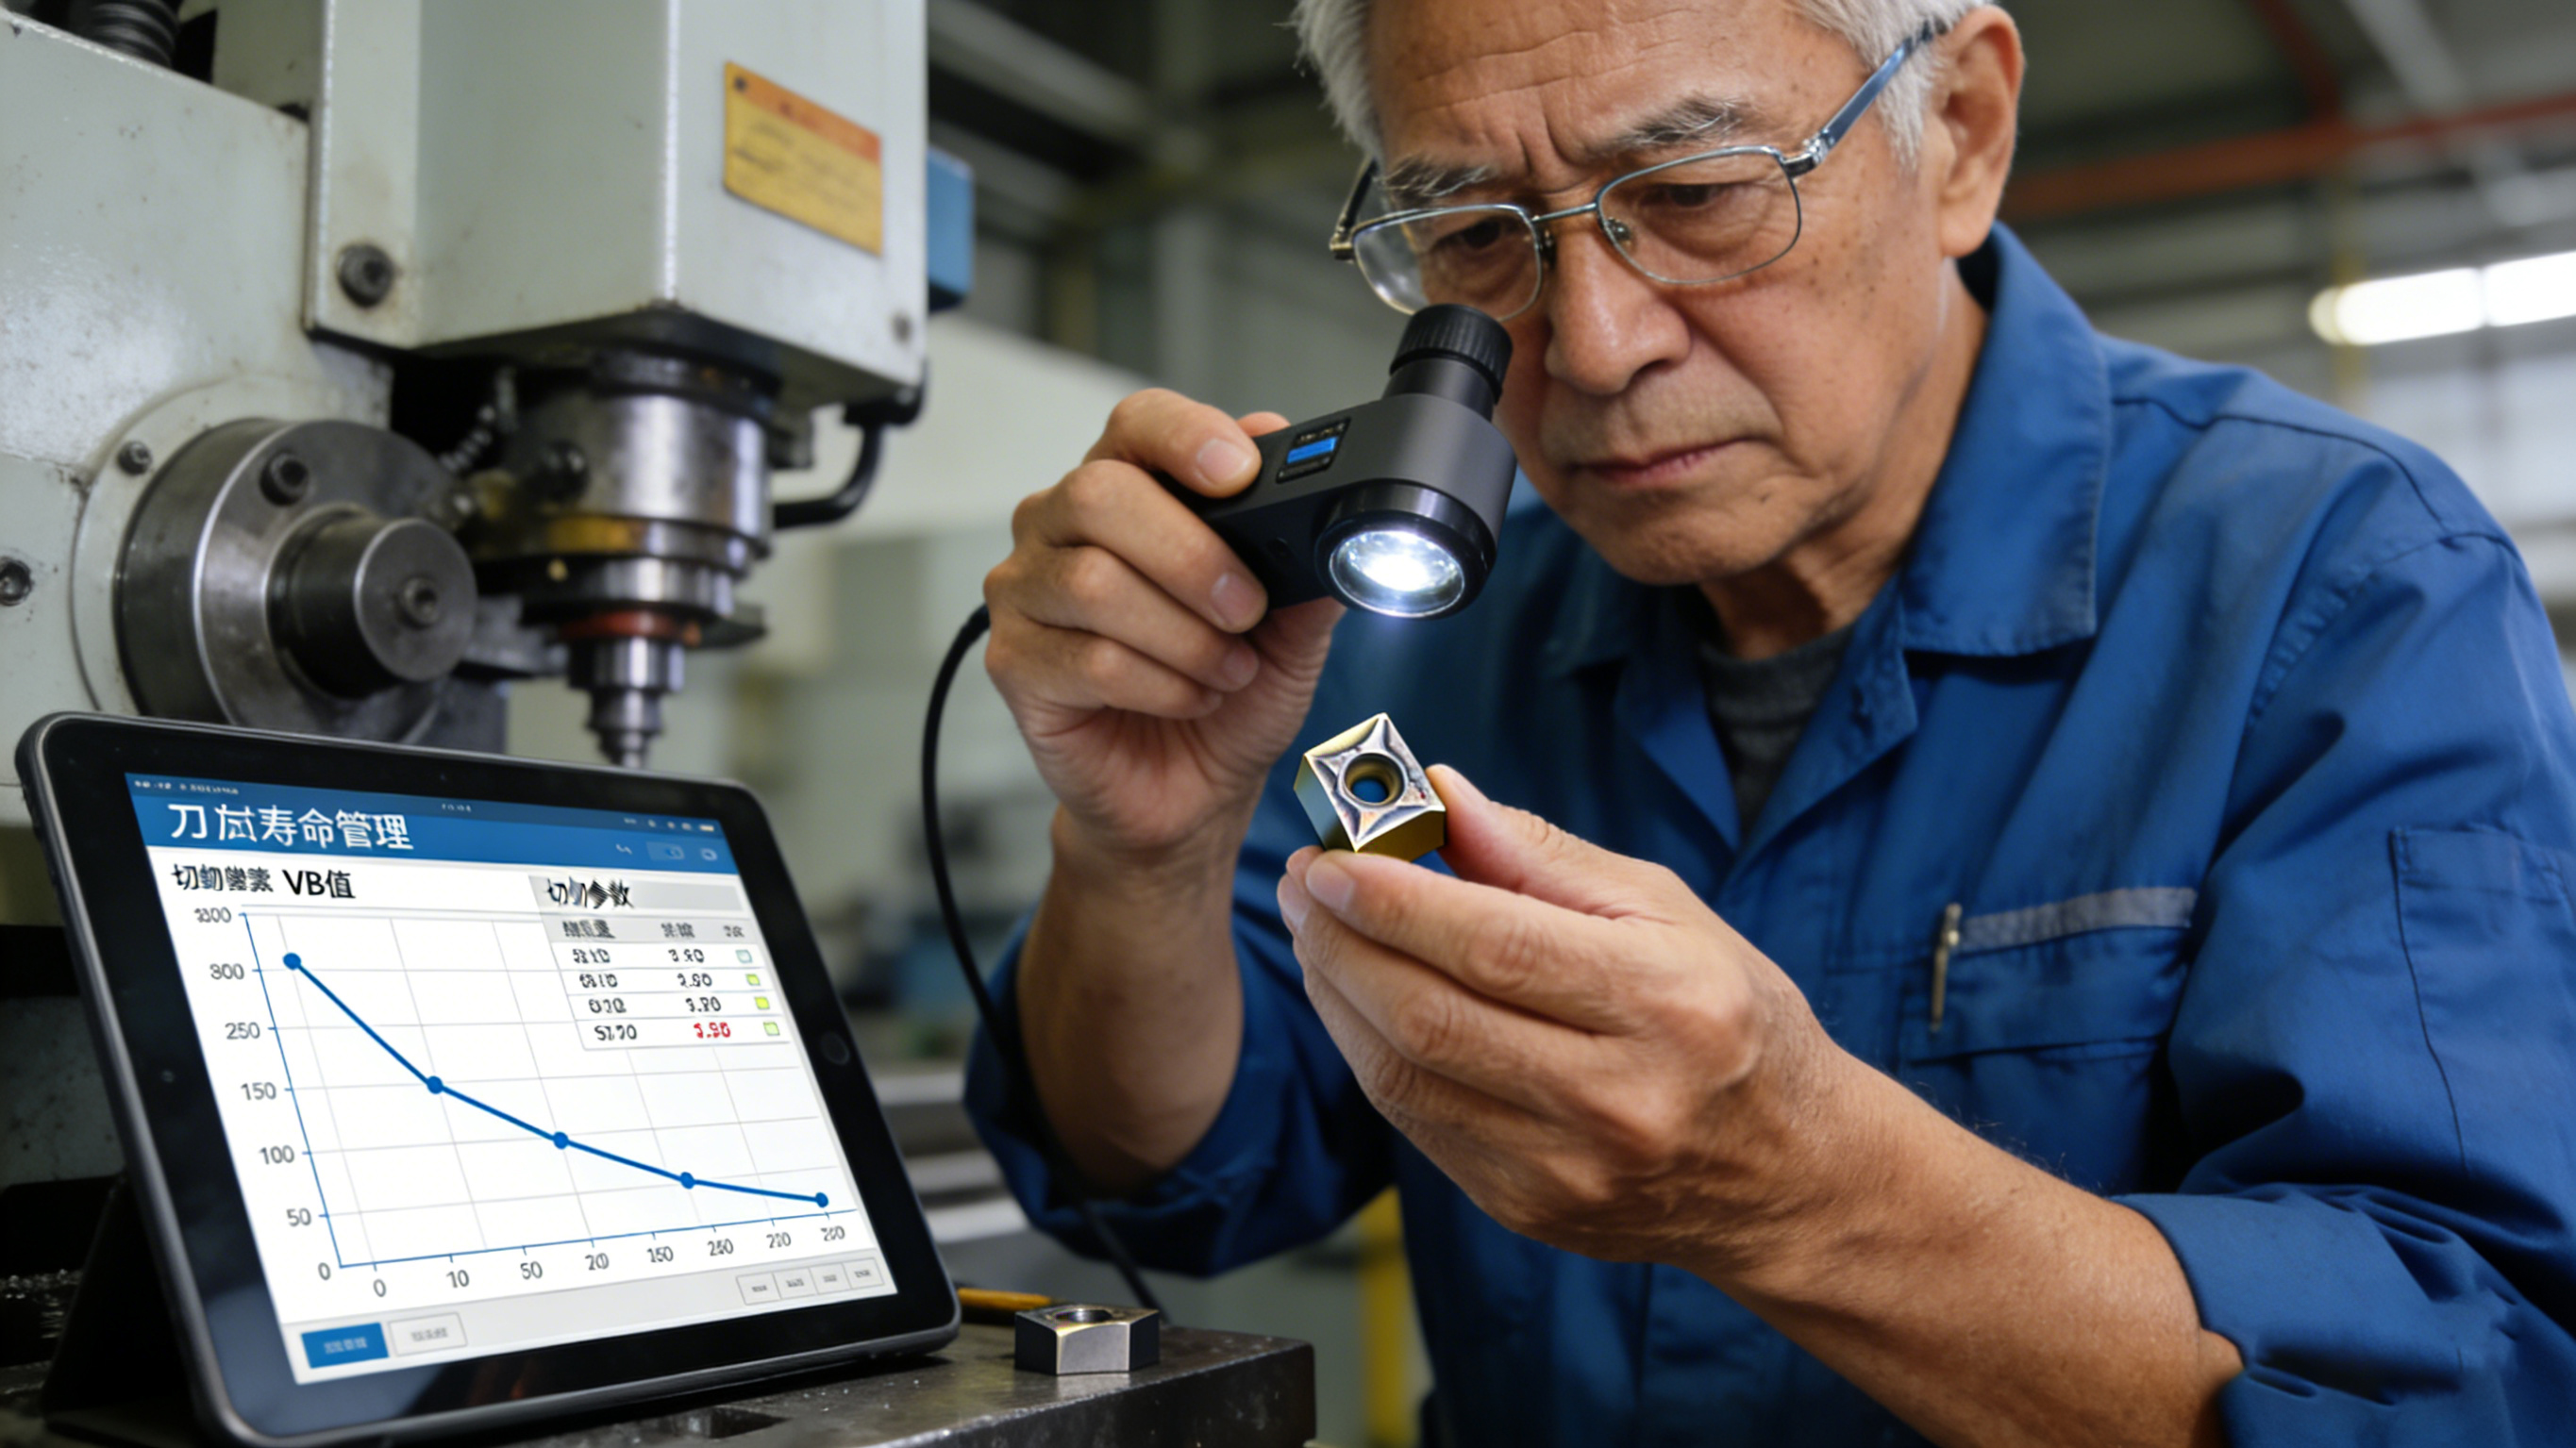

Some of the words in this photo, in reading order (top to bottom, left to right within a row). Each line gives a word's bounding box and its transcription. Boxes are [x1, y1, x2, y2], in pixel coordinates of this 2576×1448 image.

[224, 1022, 261, 1040] 250
[240, 1081, 277, 1101] 150
[259, 1144, 295, 1165] 100
[285, 1207, 312, 1227] 50
[317, 1261, 331, 1281] 0
[373, 1278, 387, 1298] 0
[445, 1269, 470, 1289] 10
[519, 1260, 544, 1280] 50
